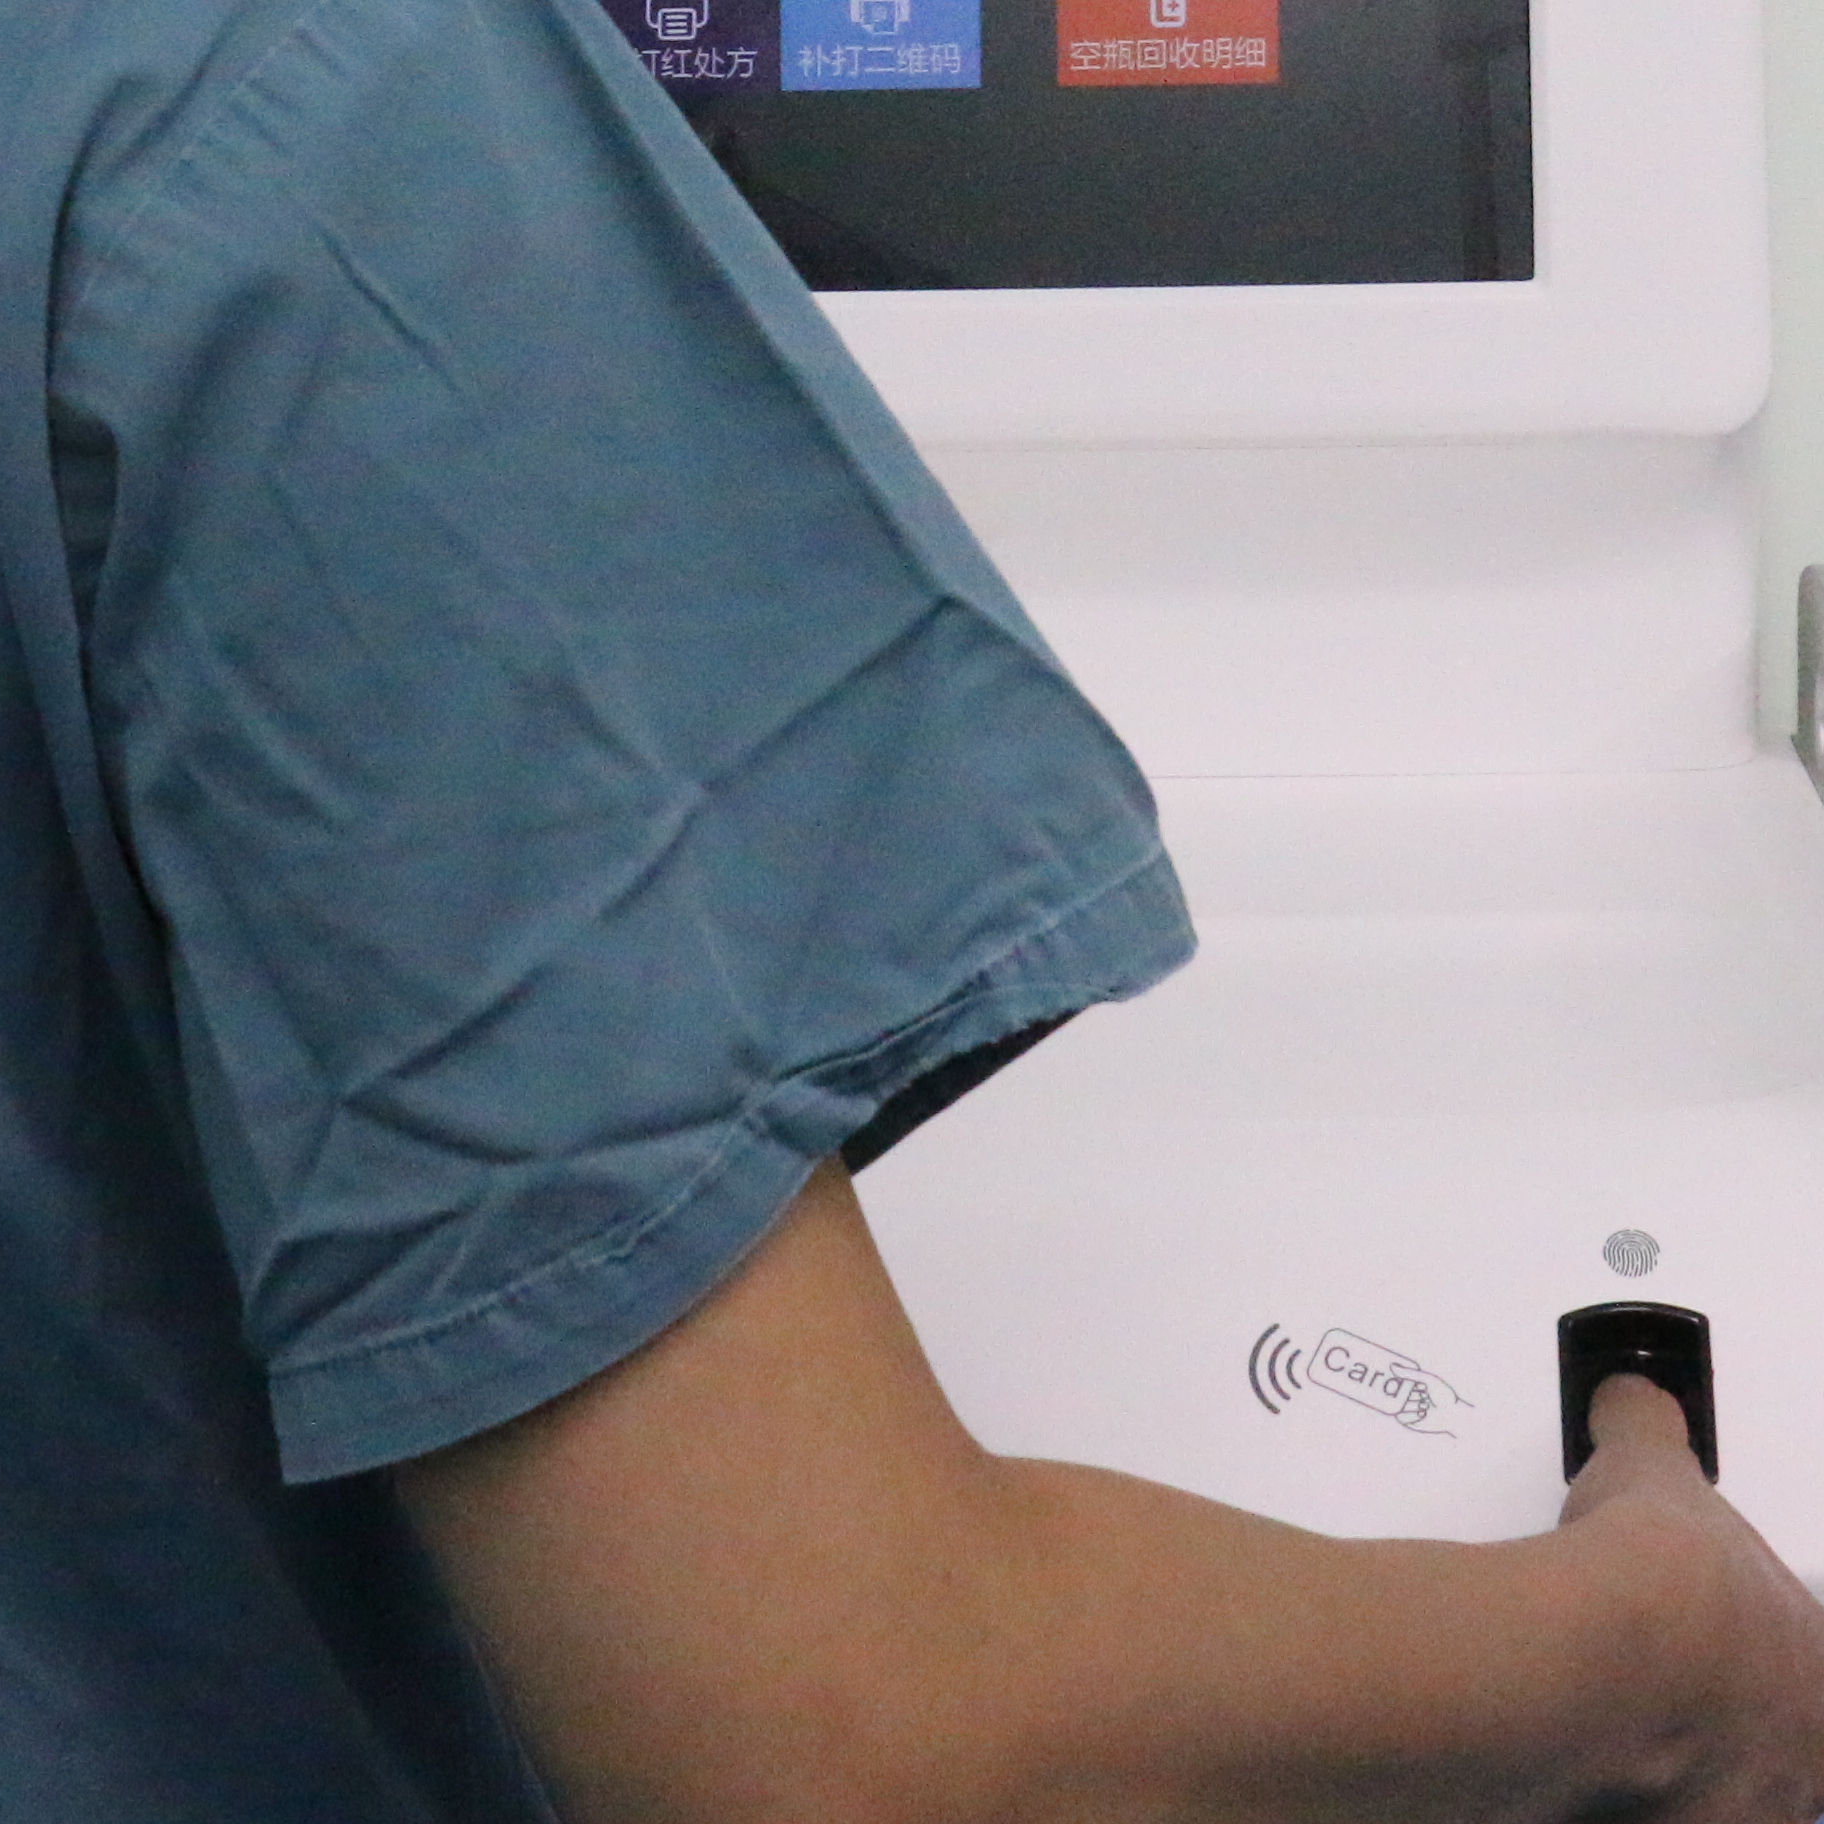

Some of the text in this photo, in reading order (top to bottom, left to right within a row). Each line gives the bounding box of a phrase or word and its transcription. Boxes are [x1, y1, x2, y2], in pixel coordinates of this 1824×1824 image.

[798, 44, 961, 76] 补打二维码
[1069, 38, 1267, 71] 空瓶回收明细
[1324, 1346, 1404, 1398] Card
